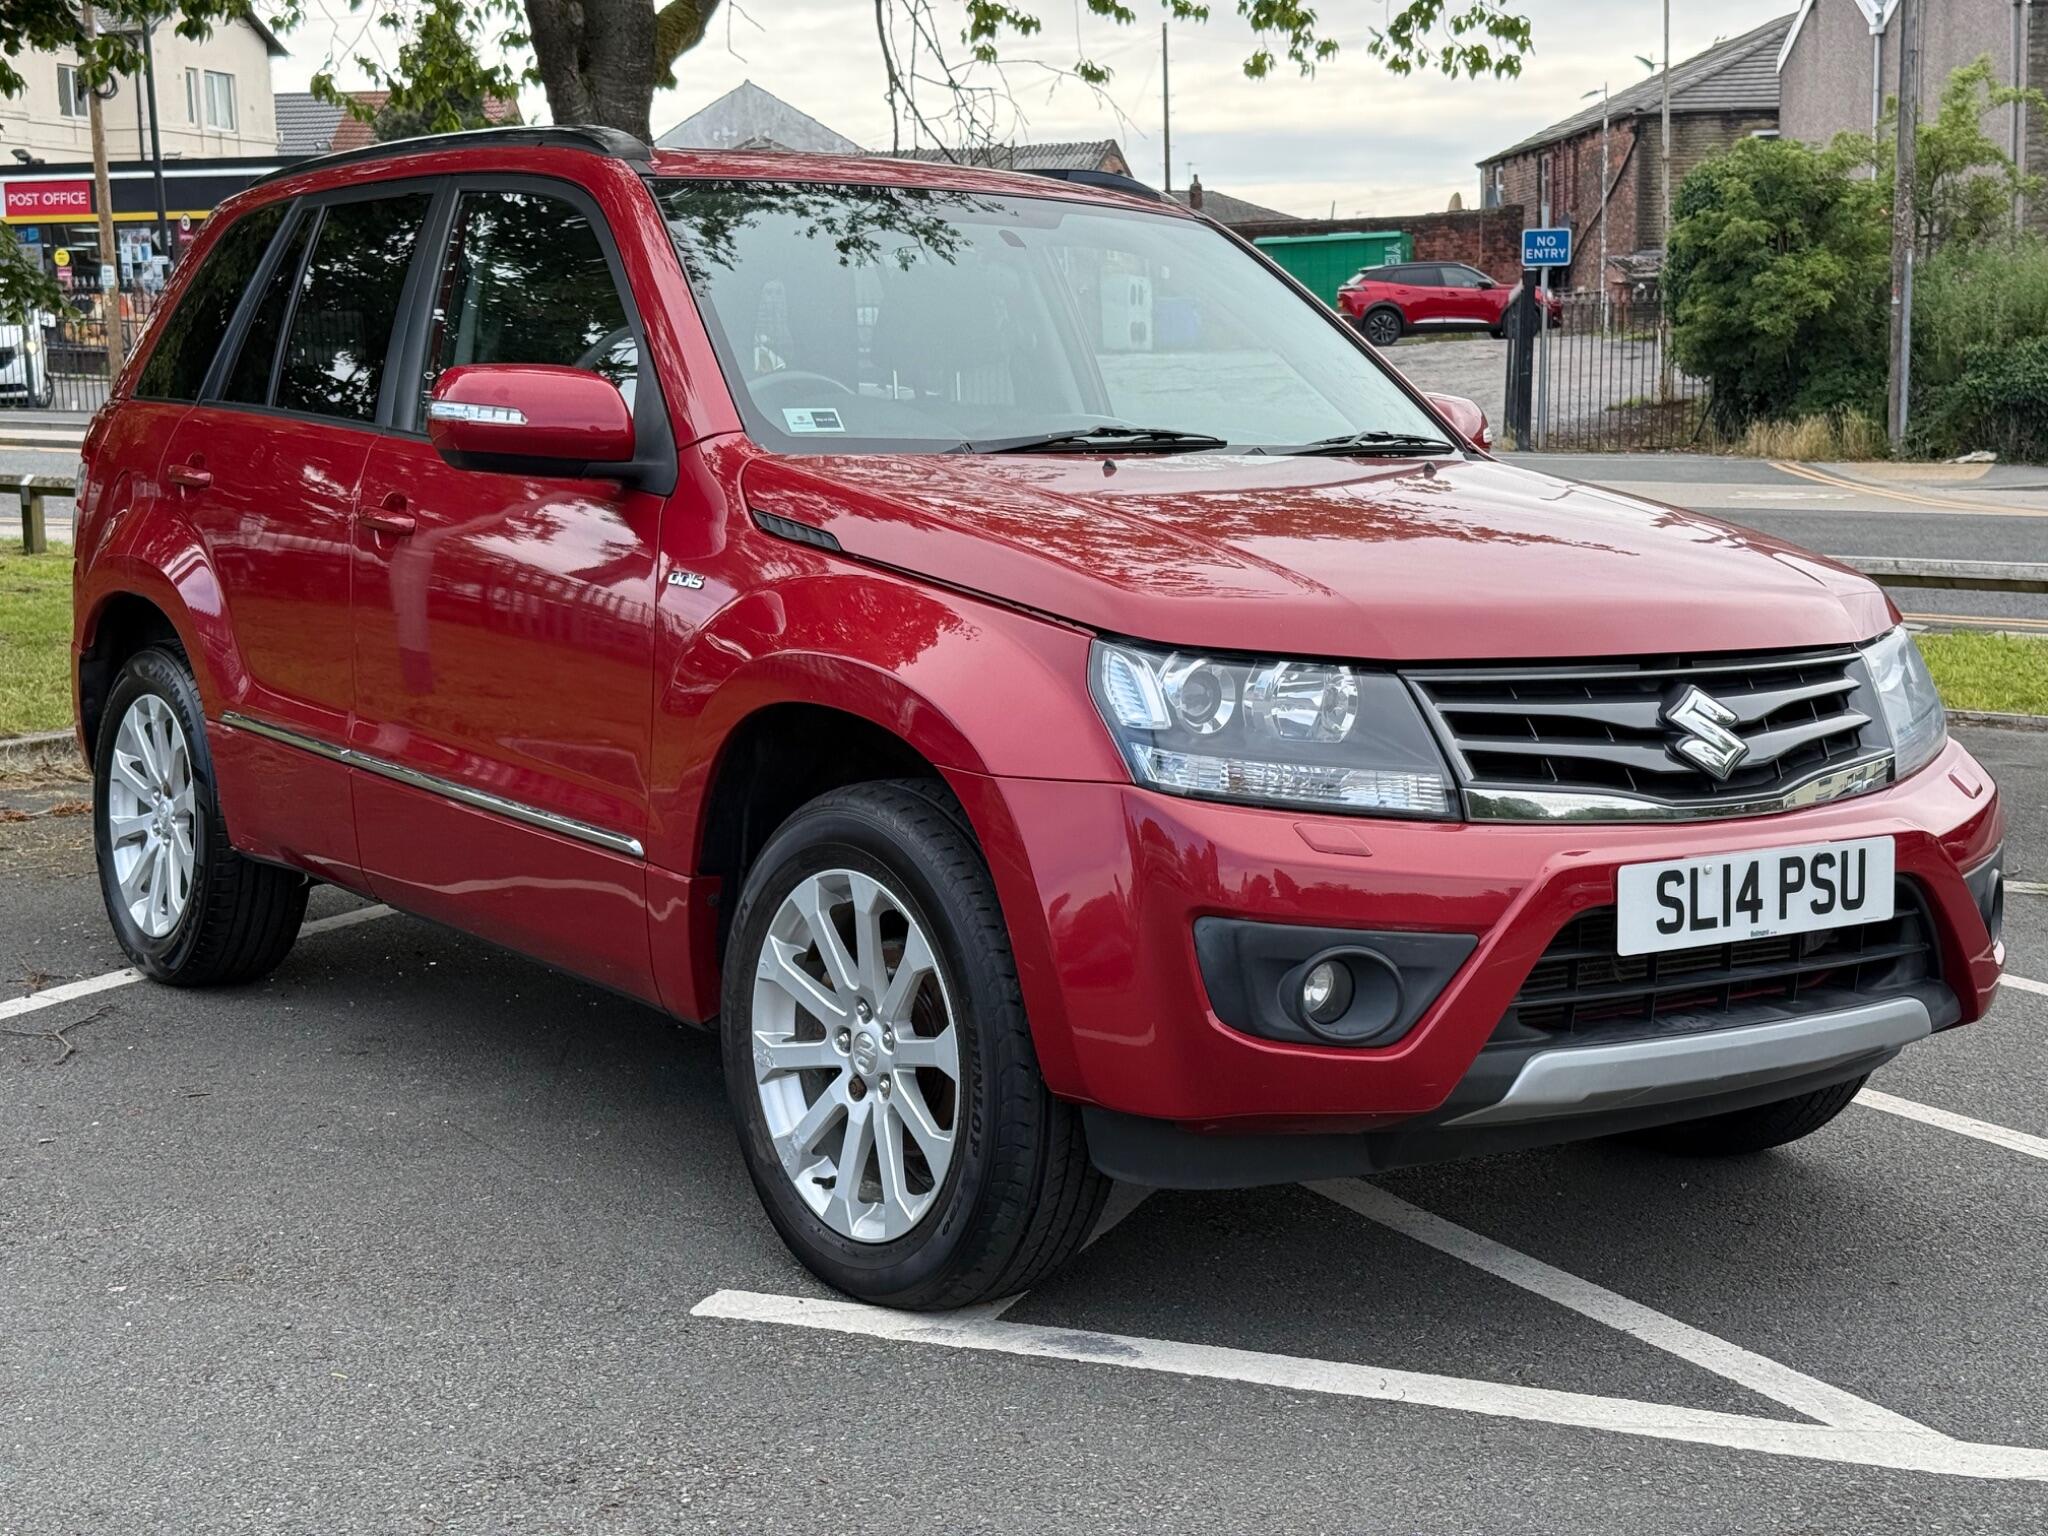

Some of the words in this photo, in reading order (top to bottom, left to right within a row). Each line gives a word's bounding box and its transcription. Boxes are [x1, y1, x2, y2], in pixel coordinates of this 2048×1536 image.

[8, 193, 40, 207] POST
[42, 191, 87, 206] OFFICE
[1536, 236, 1556, 247] NO
[1525, 248, 1567, 260] ENTRY
[1655, 860, 1764, 935] SL14
[1778, 847, 1867, 921] PSU
